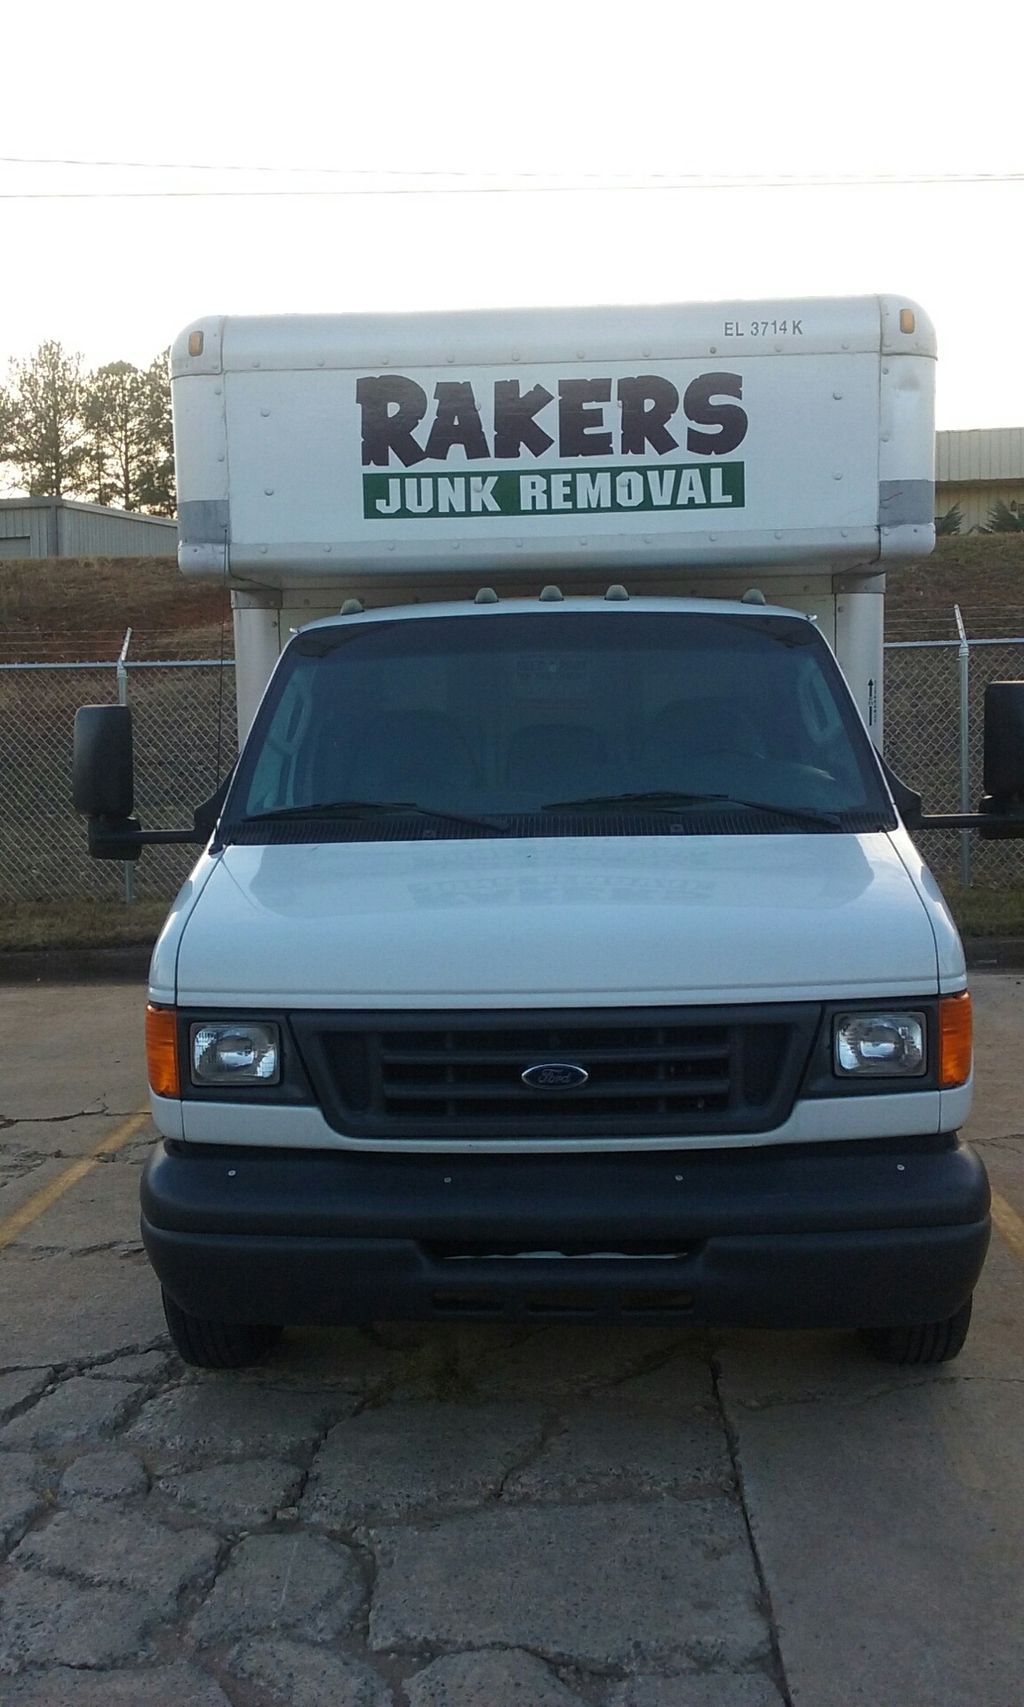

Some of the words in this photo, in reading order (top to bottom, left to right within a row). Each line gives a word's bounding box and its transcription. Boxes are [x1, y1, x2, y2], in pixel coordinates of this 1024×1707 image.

[724, 321, 744, 337] EL
[750, 319, 788, 337] 3714
[355, 371, 749, 468] RAKERS
[375, 475, 502, 514] JUNK
[519, 467, 733, 511] REMOVAL
[538, 1068, 573, 1084] Ford
